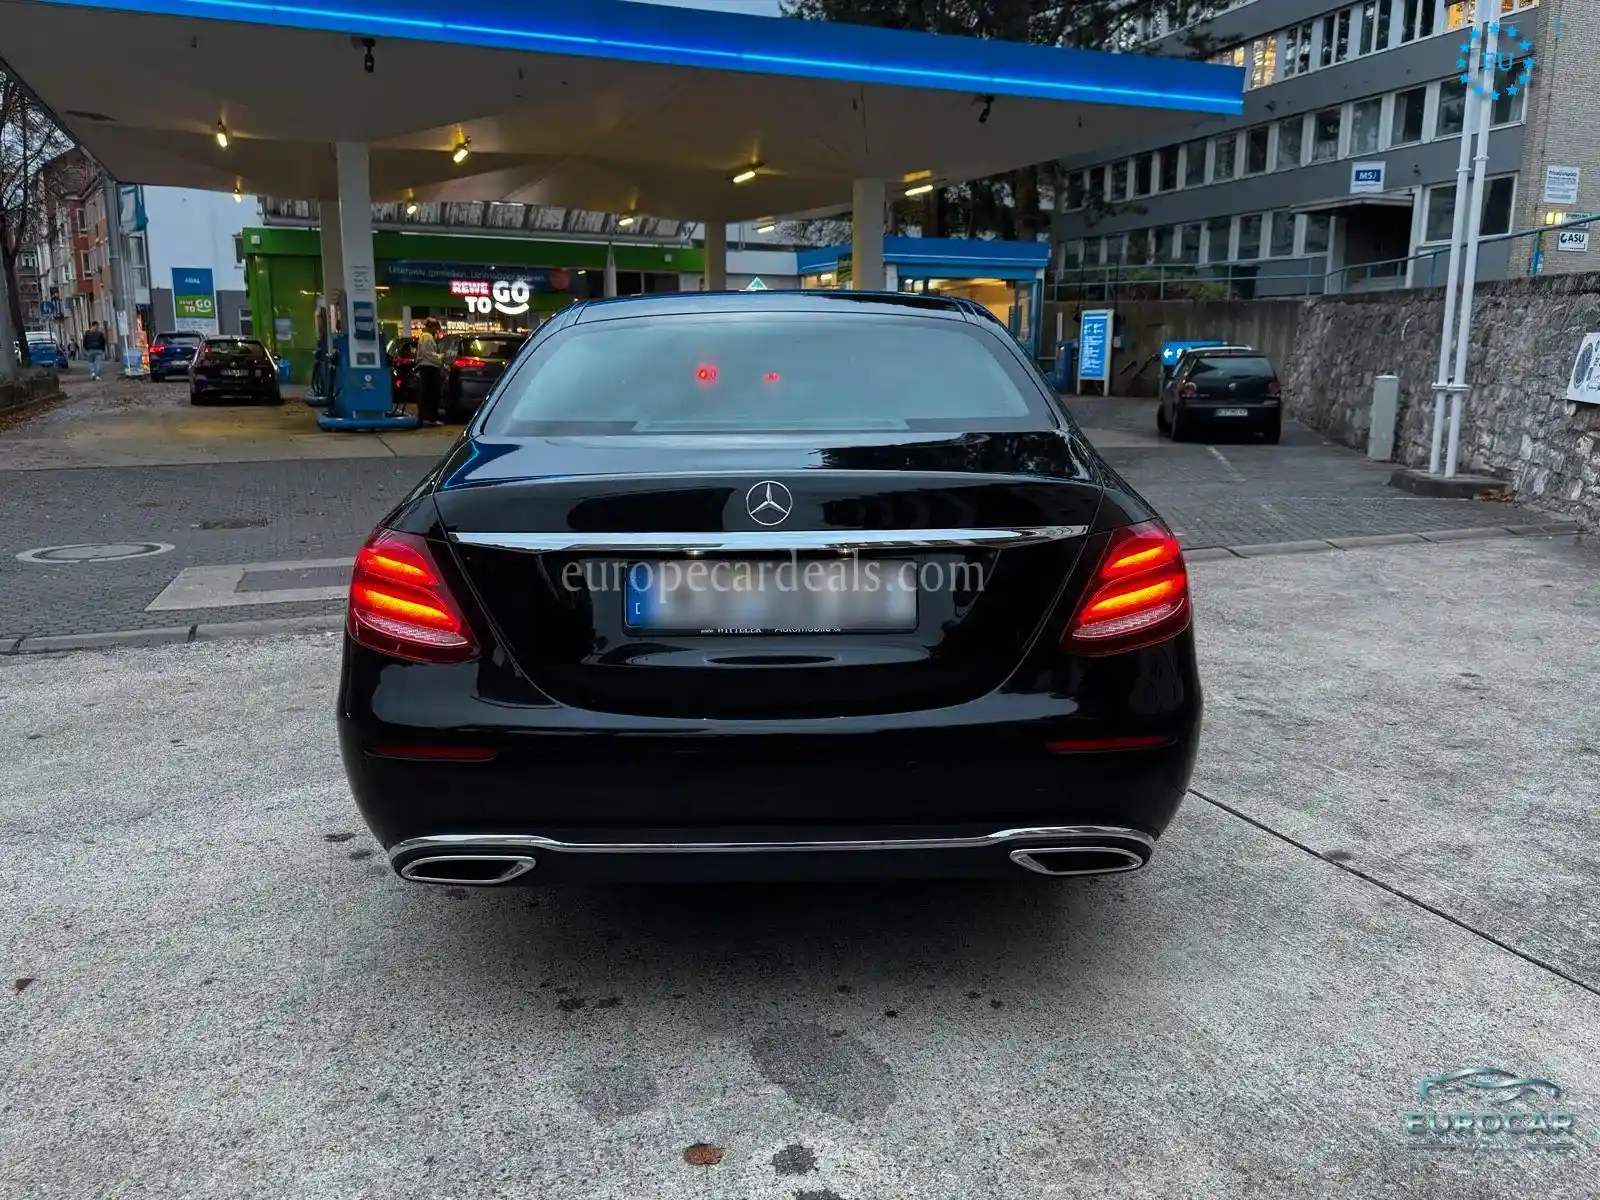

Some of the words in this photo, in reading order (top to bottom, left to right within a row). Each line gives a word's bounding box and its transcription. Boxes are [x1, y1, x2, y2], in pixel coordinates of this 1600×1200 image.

[451, 281, 490, 294] REWE
[492, 280, 530, 303] GO
[196, 299, 212, 308] GO
[465, 296, 491, 313] TO
